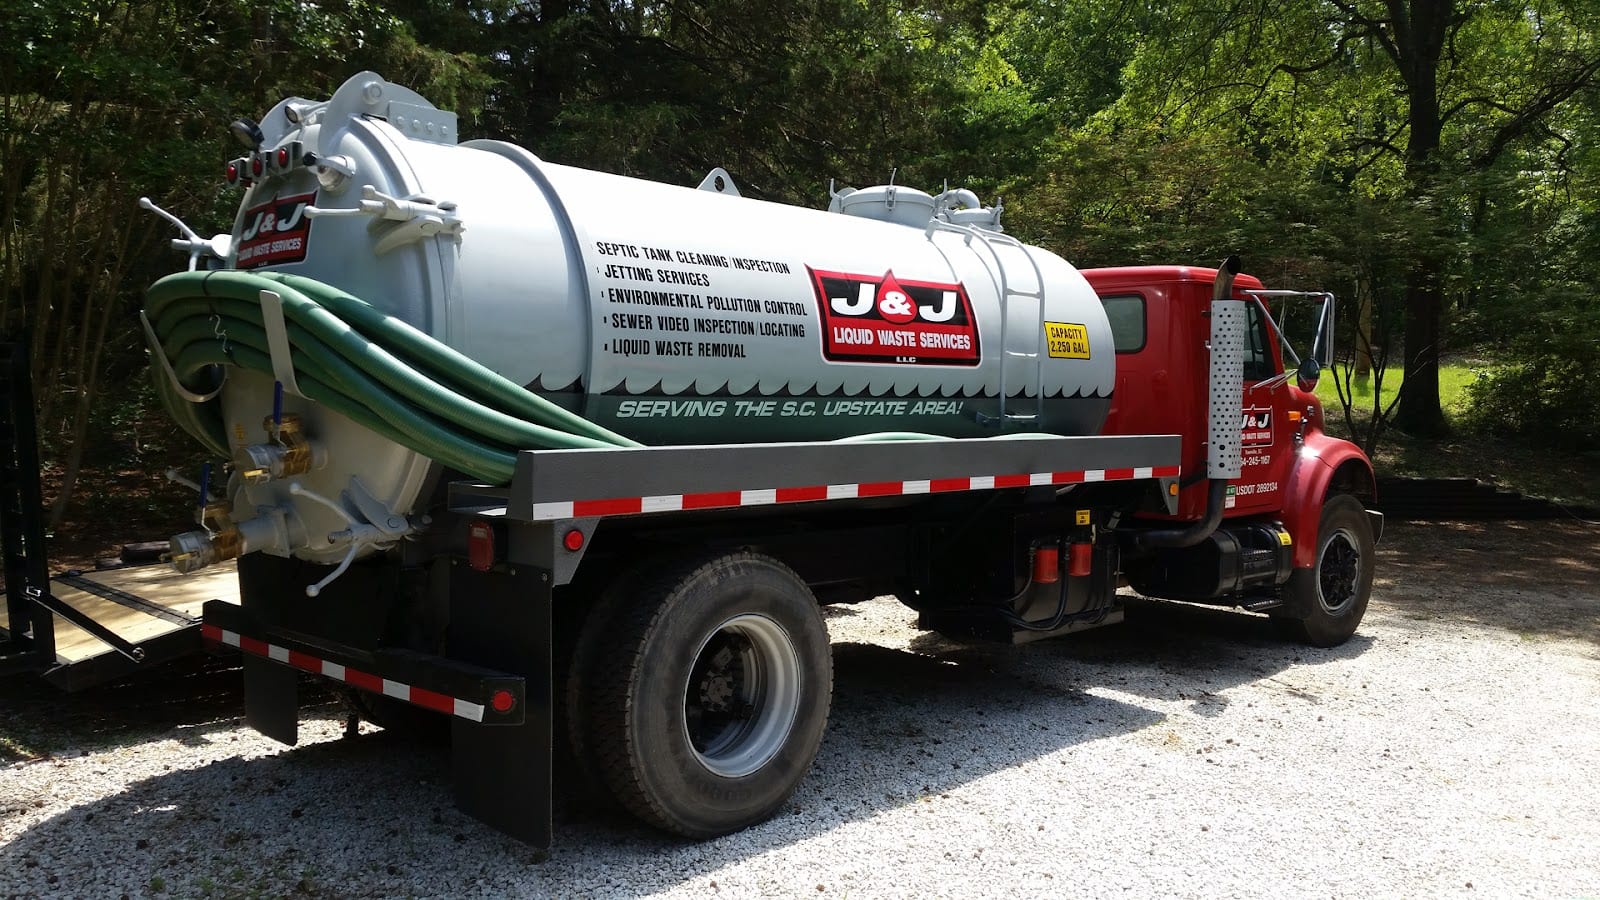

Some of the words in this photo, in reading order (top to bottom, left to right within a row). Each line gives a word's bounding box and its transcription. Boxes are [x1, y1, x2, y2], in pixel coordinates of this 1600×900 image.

[242, 202, 307, 241] J&J
[271, 237, 302, 253] SERVICES
[596, 241, 640, 258] SEPTIC
[641, 246, 674, 262] TANK
[676, 250, 790, 275] CLEANING/INSPECTION
[604, 264, 653, 282] JETTING
[658, 270, 710, 287] SERVICES
[608, 288, 704, 309] ENVIRONMENTAL
[706, 295, 762, 313] POLLUTION
[764, 299, 808, 316] CONTROL
[830, 282, 957, 323] J&J
[612, 313, 653, 330] SEWER
[657, 315, 690, 332] VIDEO
[694, 318, 806, 337] INSPECTION/LOCATING
[1050, 327, 1083, 340] CAPACITY
[612, 339, 650, 357] LIQUID
[655, 341, 693, 356] WASTE
[698, 342, 747, 358] REMOVAL
[834, 326, 874, 344] LIQUID
[877, 330, 917, 347] WASTE
[920, 332, 971, 350] SERVICES
[616, 400, 728, 418] SERVING
[734, 401, 777, 417] THE
[780, 401, 817, 416] S.C.
[823, 401, 907, 416] UPSTATE
[909, 401, 964, 415] AREA!
[1235, 484, 1256, 496] USDOT
